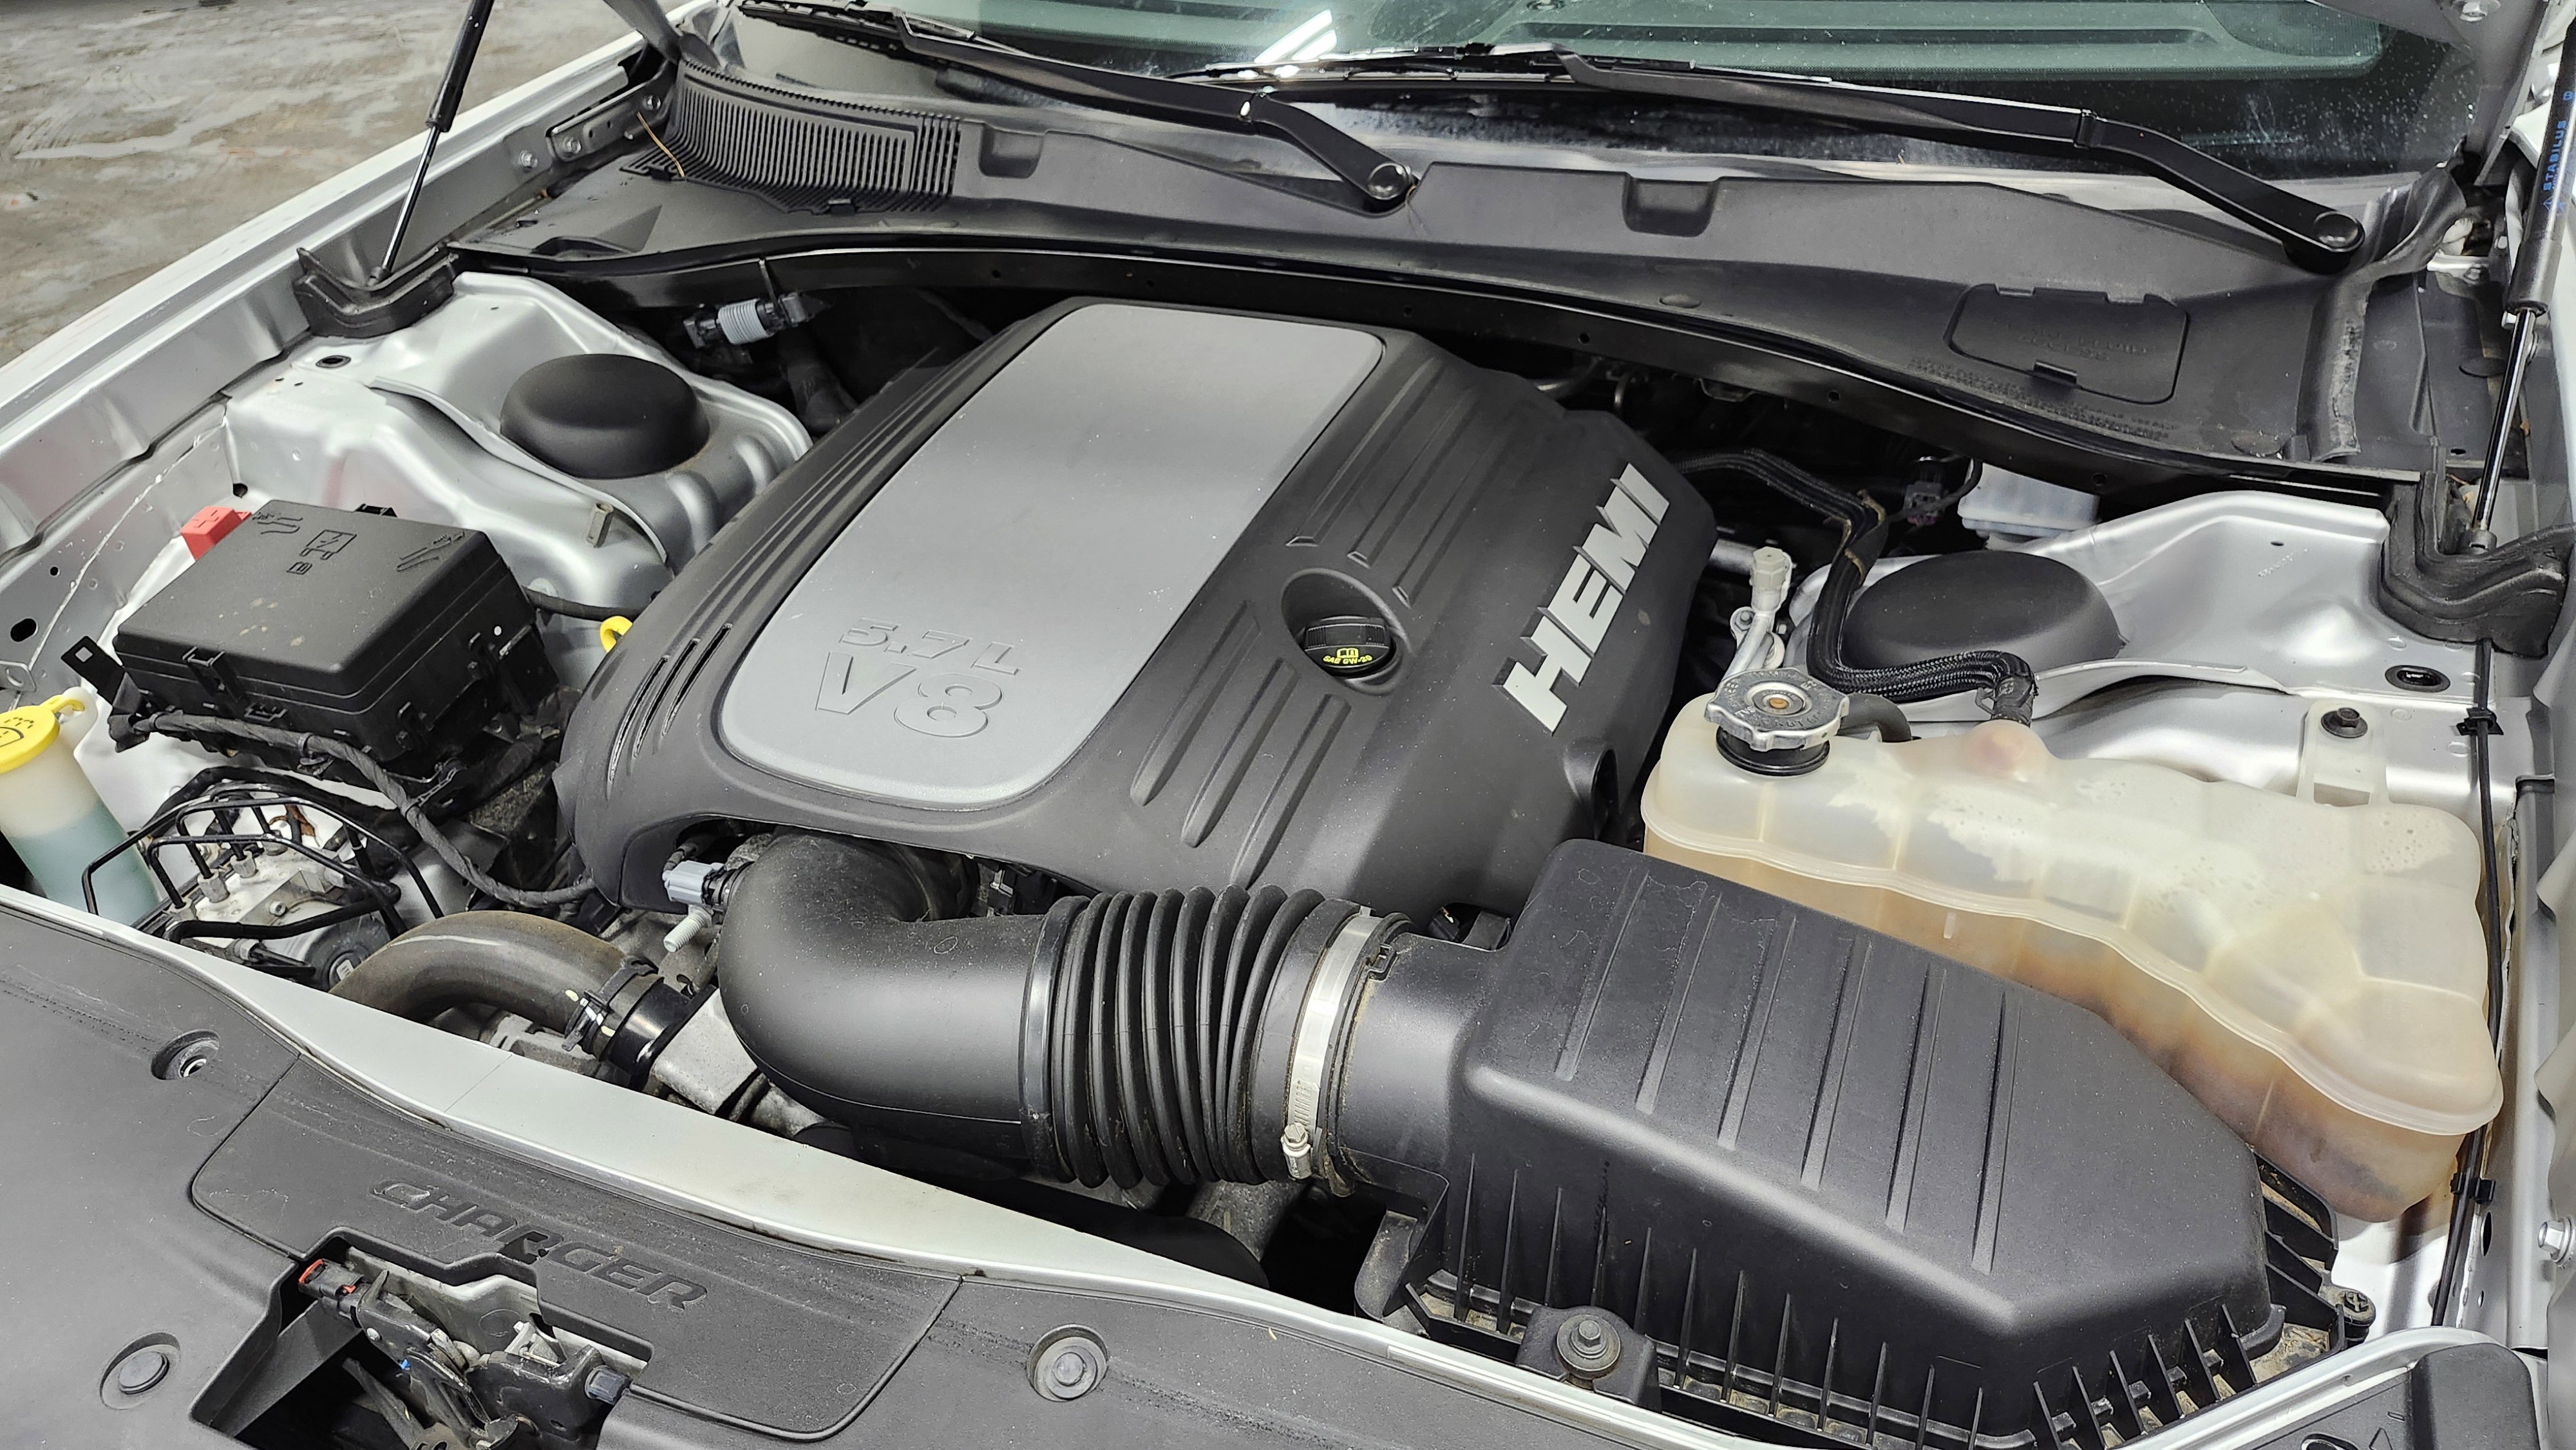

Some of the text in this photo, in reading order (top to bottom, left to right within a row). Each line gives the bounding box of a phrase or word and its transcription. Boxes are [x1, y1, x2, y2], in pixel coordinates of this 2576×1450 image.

[2543, 120, 2566, 191] STABILUS
[1493, 462, 1670, 735] HEMI
[838, 617, 1023, 675] 5.7L
[1323, 655, 1373, 664] SAE 0W-20
[815, 650, 1003, 738] V8
[370, 1180, 707, 1311] CHARGER
